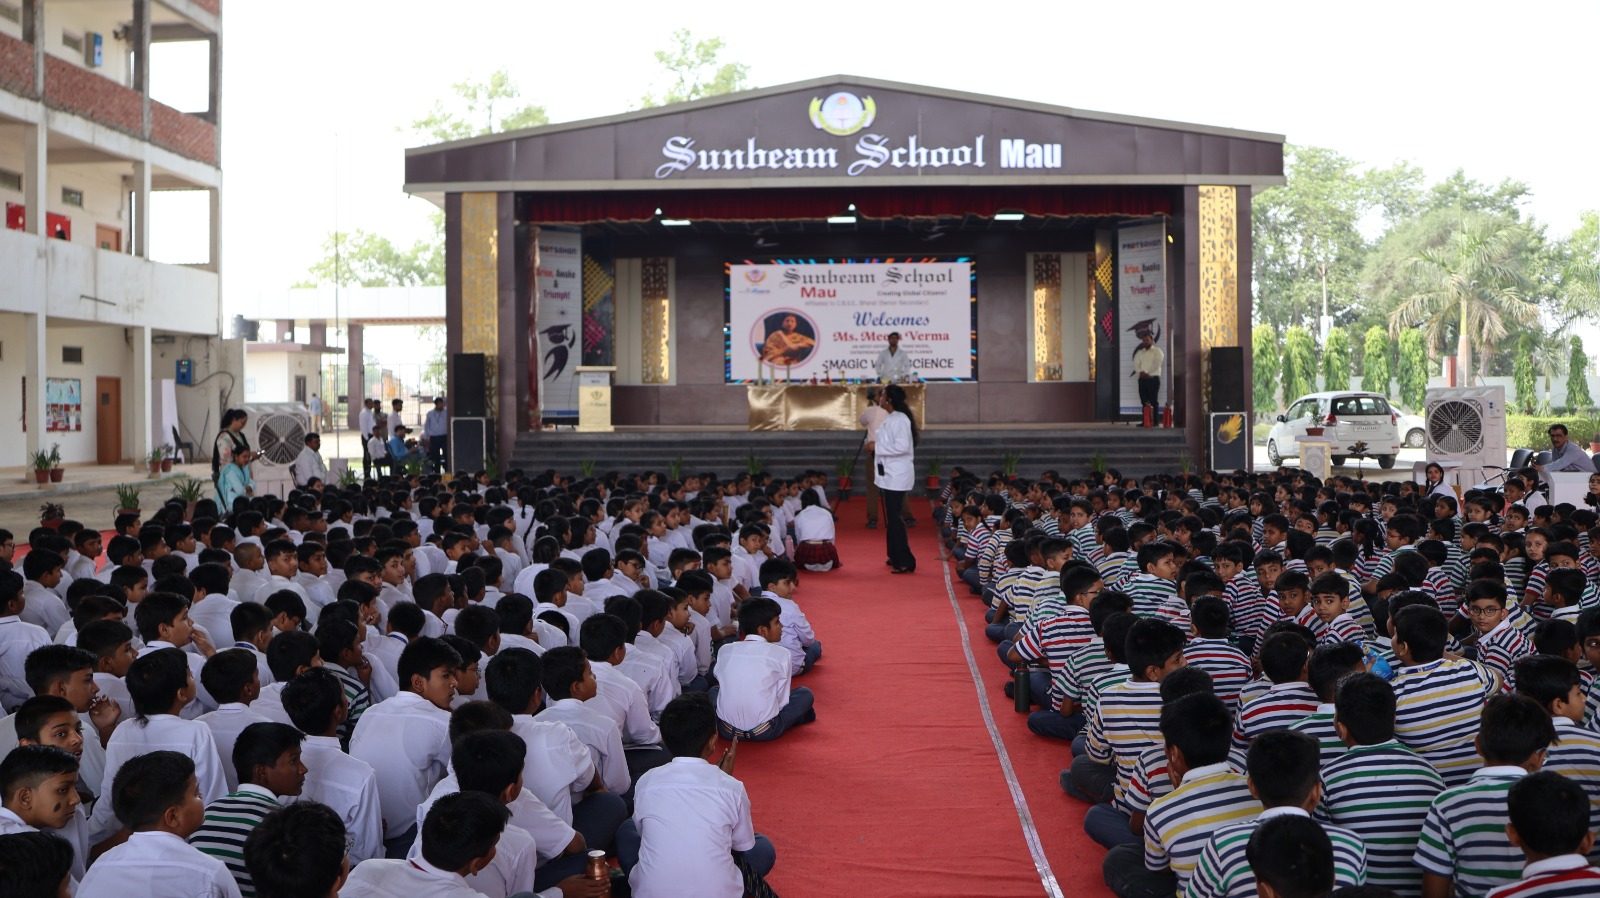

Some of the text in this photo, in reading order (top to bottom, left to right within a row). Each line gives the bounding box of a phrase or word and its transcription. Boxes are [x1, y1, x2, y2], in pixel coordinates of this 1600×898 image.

[655, 134, 1062, 178] Sunbeam School Mau
[780, 266, 953, 288] Sunbeam School
[801, 286, 837, 298] Mau
[853, 311, 930, 327] Welcomes
[833, 331, 858, 342] Ms.
[905, 330, 950, 341] Verma
